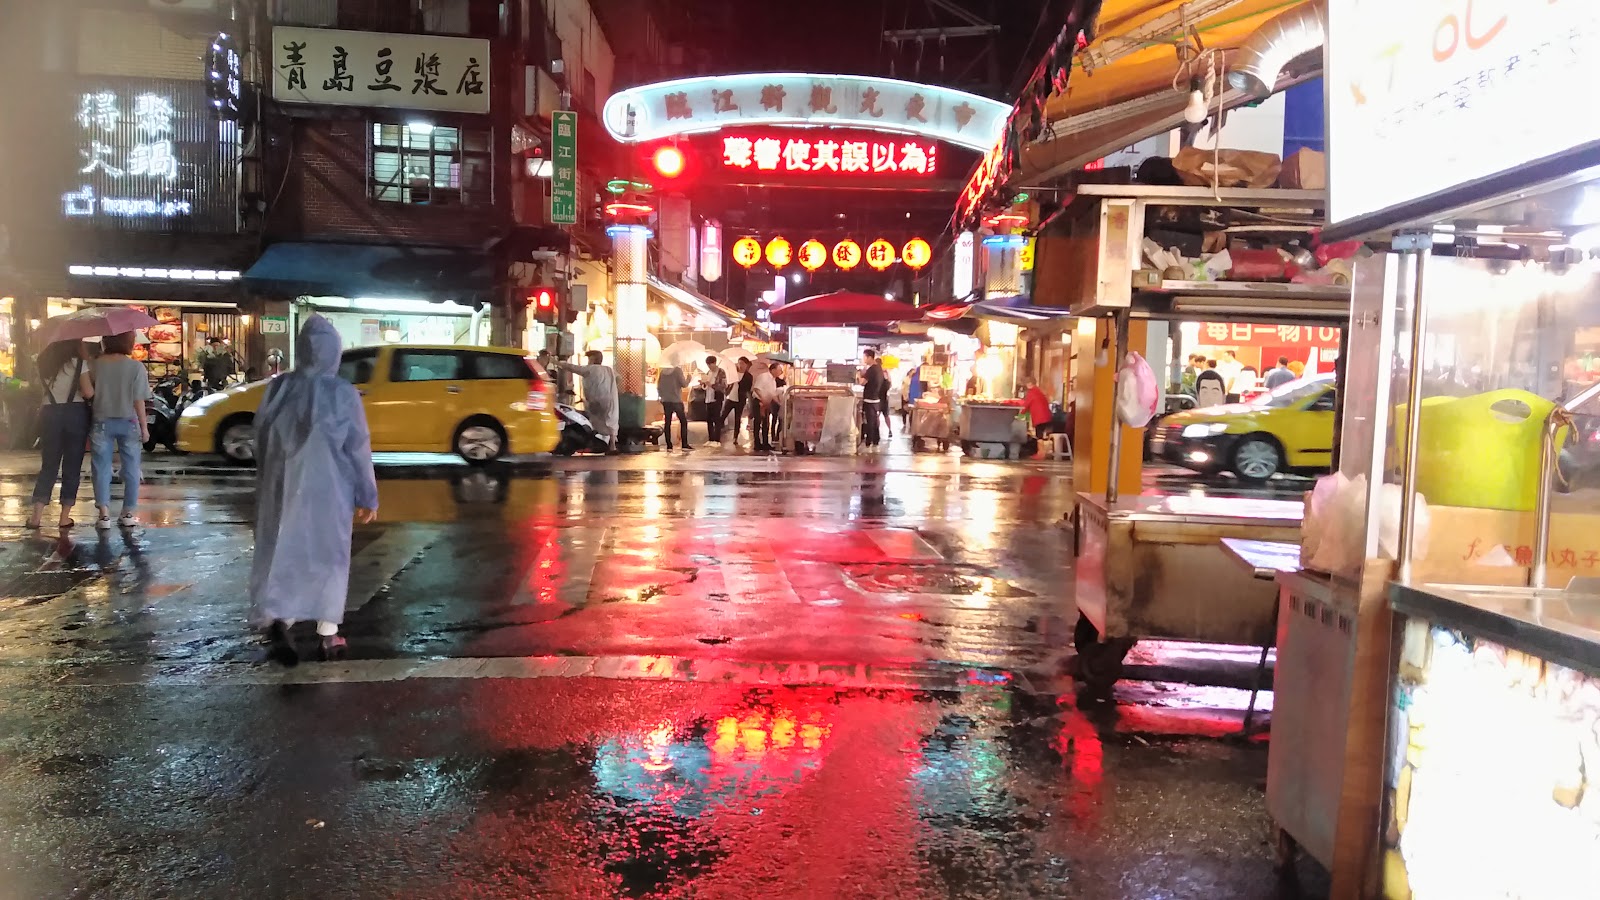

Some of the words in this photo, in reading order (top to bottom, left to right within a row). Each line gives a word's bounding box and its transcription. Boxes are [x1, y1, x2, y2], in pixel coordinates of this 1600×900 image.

[280, 41, 483, 96] 青島豆漿店
[79, 139, 177, 180] 火鍋
[558, 124, 571, 180] 臨江街
[723, 136, 936, 174] 聲響使其誤以為
[553, 189, 573, 197] Jiang
[268, 323, 281, 331] 73
[1206, 322, 1340, 342] 每日一物10
